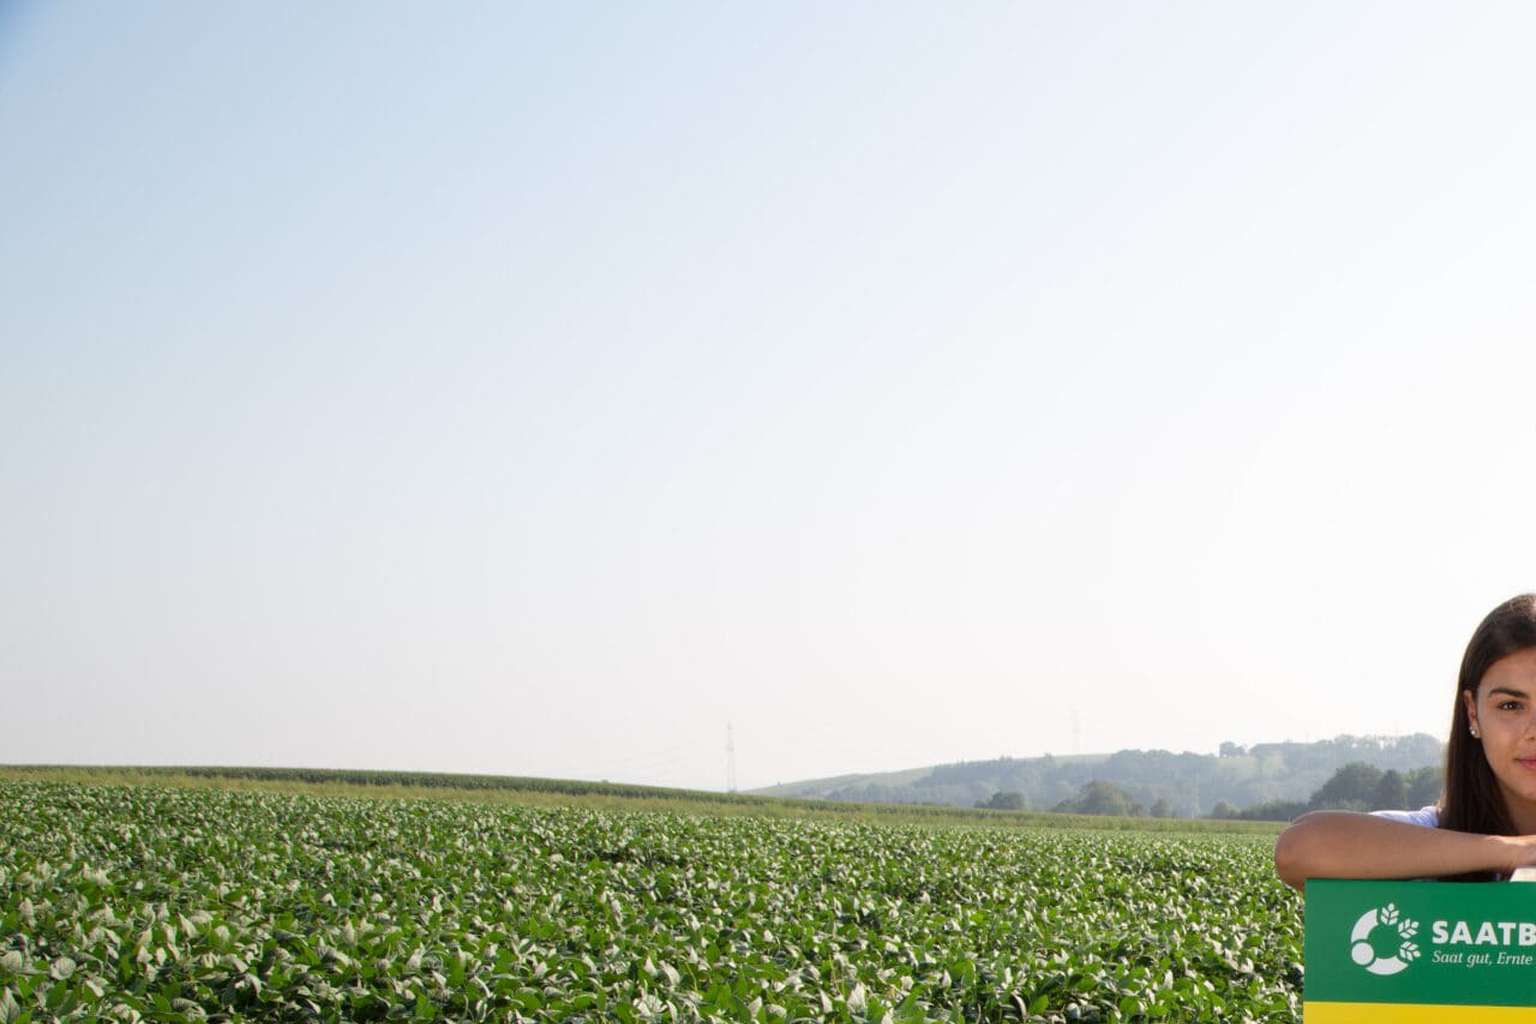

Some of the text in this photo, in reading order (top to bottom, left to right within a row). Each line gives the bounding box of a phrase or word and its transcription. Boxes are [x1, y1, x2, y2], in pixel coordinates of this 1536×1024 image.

[1431, 950, 1463, 964] Saat
[1466, 952, 1493, 968] gut,
[1496, 951, 1533, 966] Ernte
